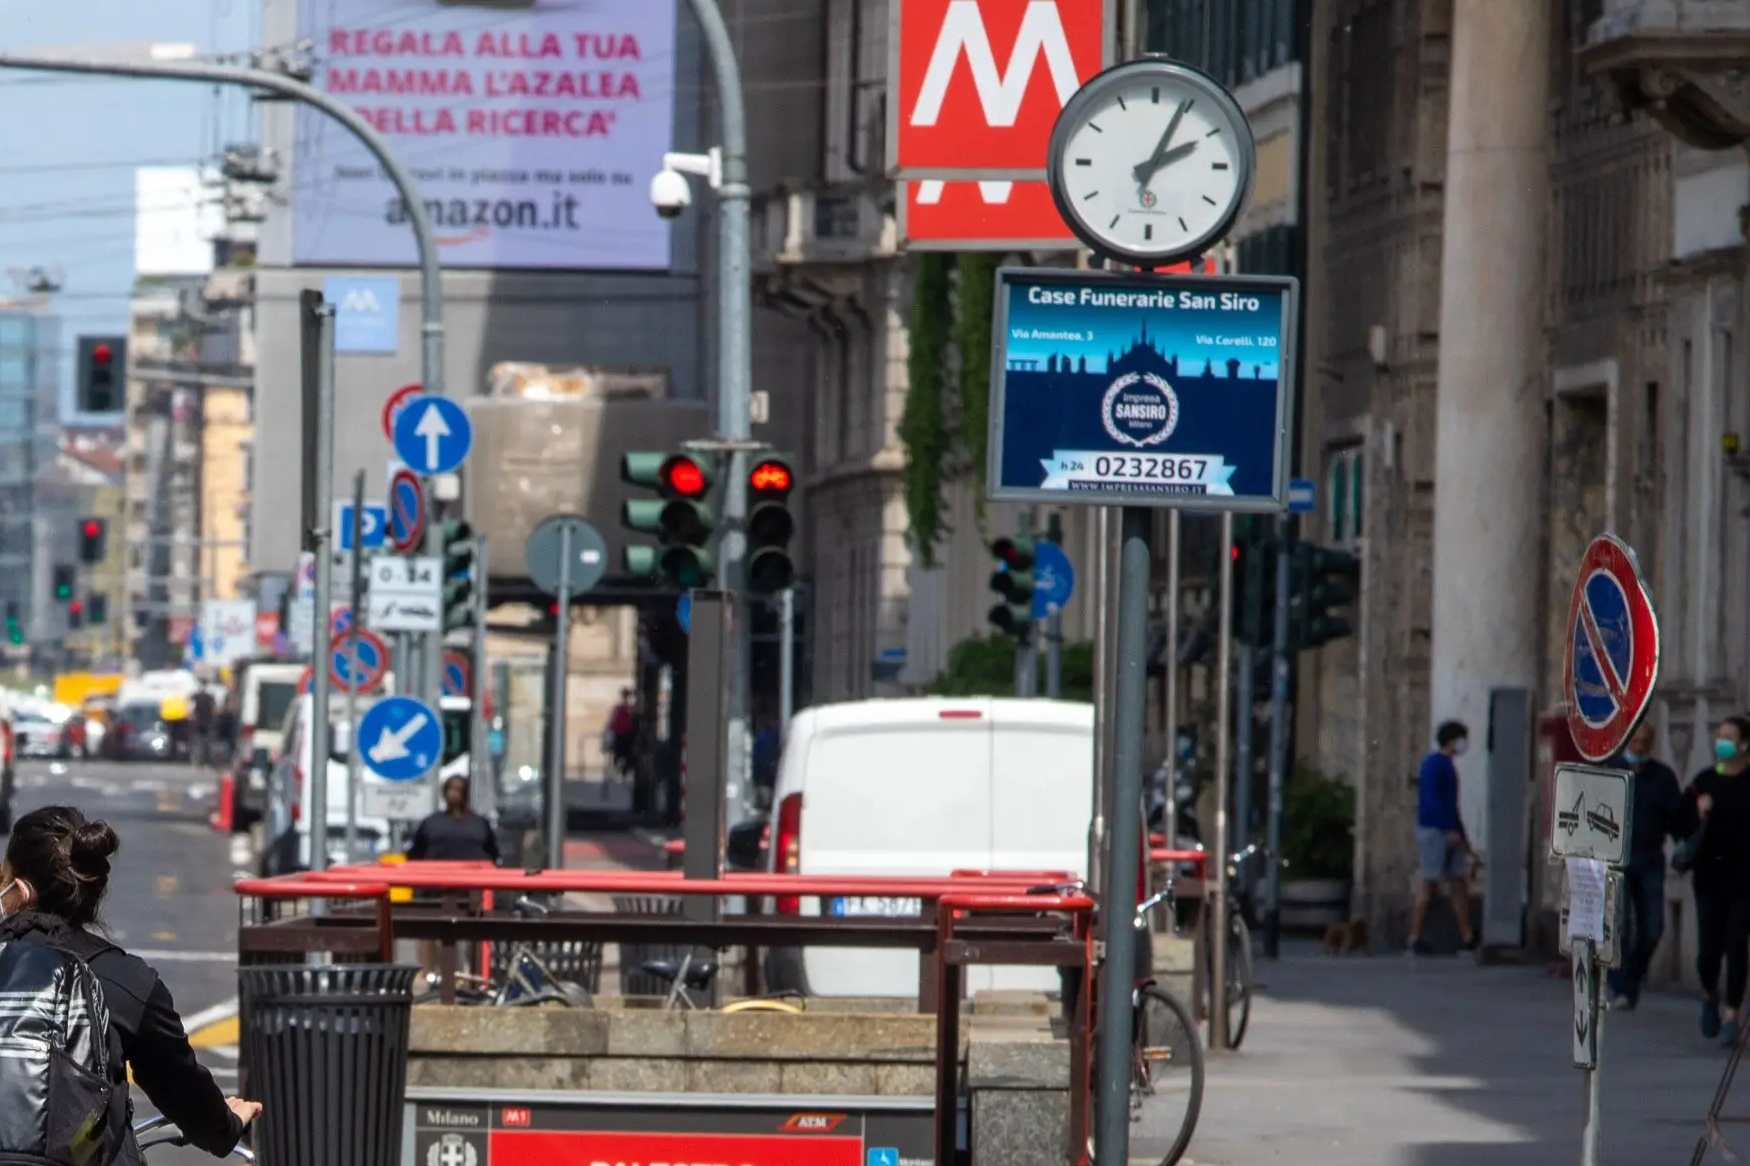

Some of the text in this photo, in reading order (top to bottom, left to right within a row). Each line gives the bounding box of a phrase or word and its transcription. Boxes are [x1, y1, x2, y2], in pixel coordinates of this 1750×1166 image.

[329, 29, 642, 60] REGALA ALLA TUA
[909, 0, 1082, 127] M
[328, 69, 642, 98] MAMMA L'AZALEA
[1028, 286, 1260, 312] Case Funerarie San Siro
[1012, 328, 1029, 339] Via
[1196, 335, 1213, 345] Via
[1257, 336, 1277, 348] 120
[1115, 403, 1167, 420] SANSIRO
[1095, 456, 1208, 481] 0232867
[427, 1110, 479, 1125] Milano
